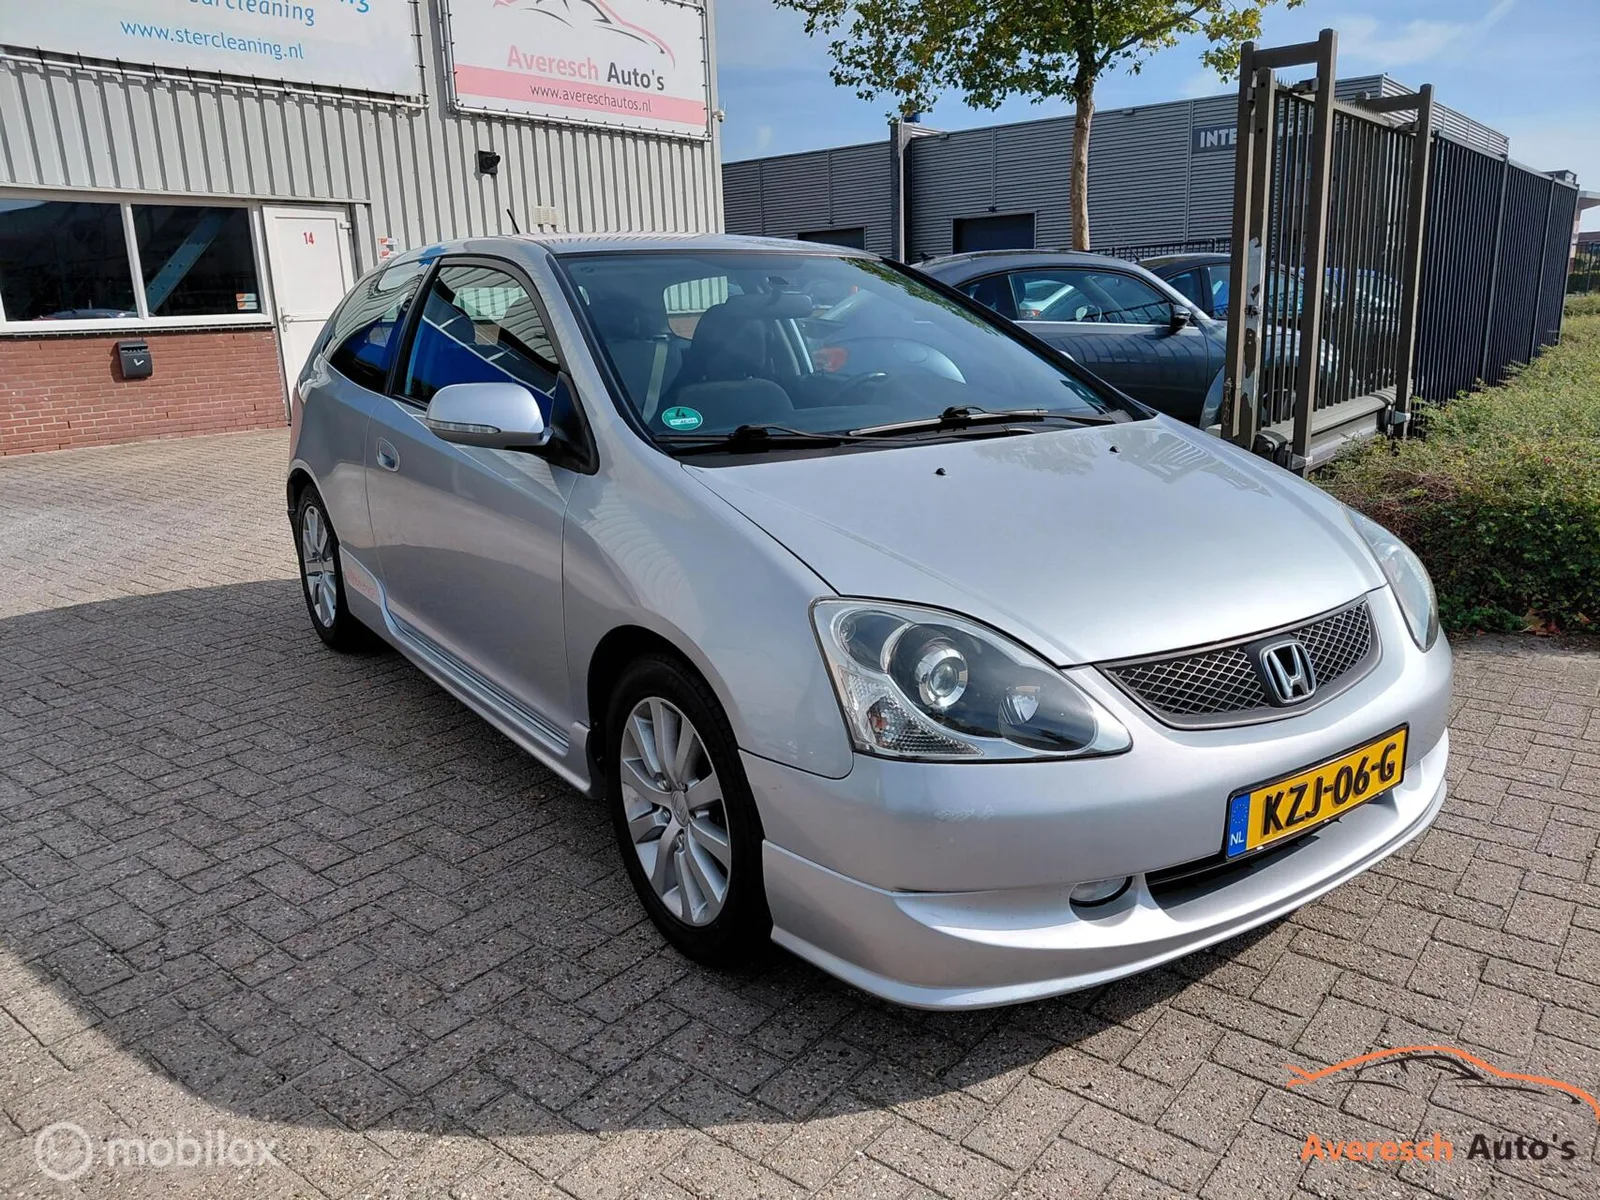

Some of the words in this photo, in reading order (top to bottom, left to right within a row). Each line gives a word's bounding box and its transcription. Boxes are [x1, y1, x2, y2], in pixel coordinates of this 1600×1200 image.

[120, 21, 304, 60] www.stercleaning.nl
[507, 45, 599, 81] Averesch
[607, 62, 665, 91] Auto's
[530, 84, 652, 112] www.avereschautos.nl
[303, 232, 315, 245] 14
[1261, 743, 1397, 836] KZJ-06-G
[1229, 830, 1246, 846] NL
